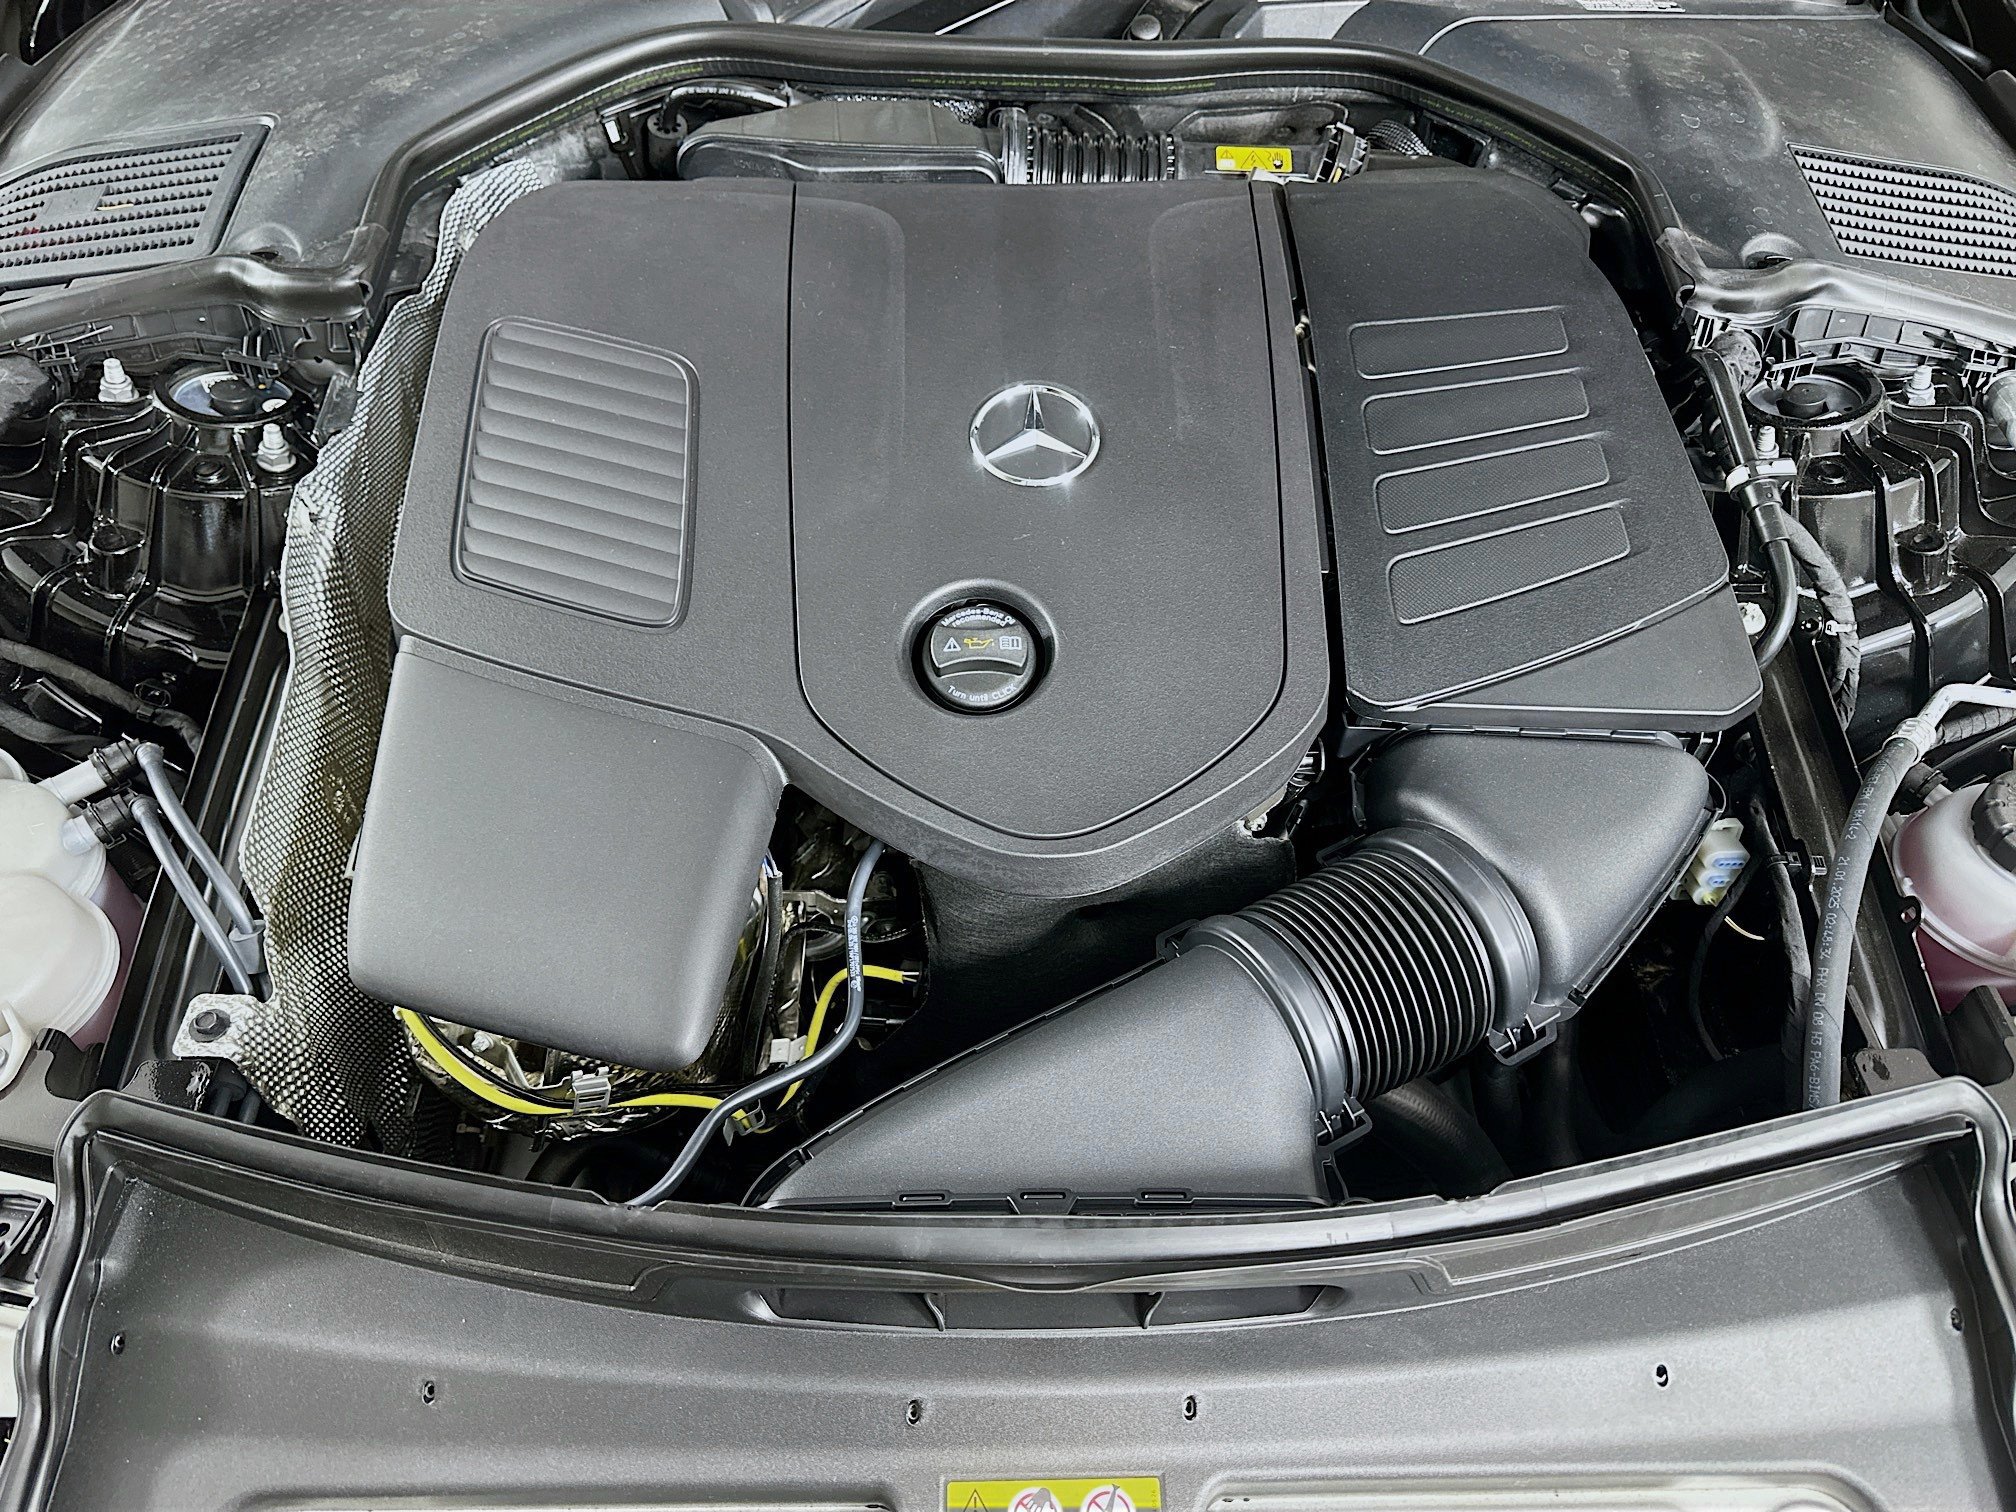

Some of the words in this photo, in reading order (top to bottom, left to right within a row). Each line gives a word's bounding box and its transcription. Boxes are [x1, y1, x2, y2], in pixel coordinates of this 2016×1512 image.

[951, 614, 1007, 628] recommended
[947, 685, 967, 700] Turn
[968, 693, 989, 702] until
[991, 683, 1018, 700] CLICK
